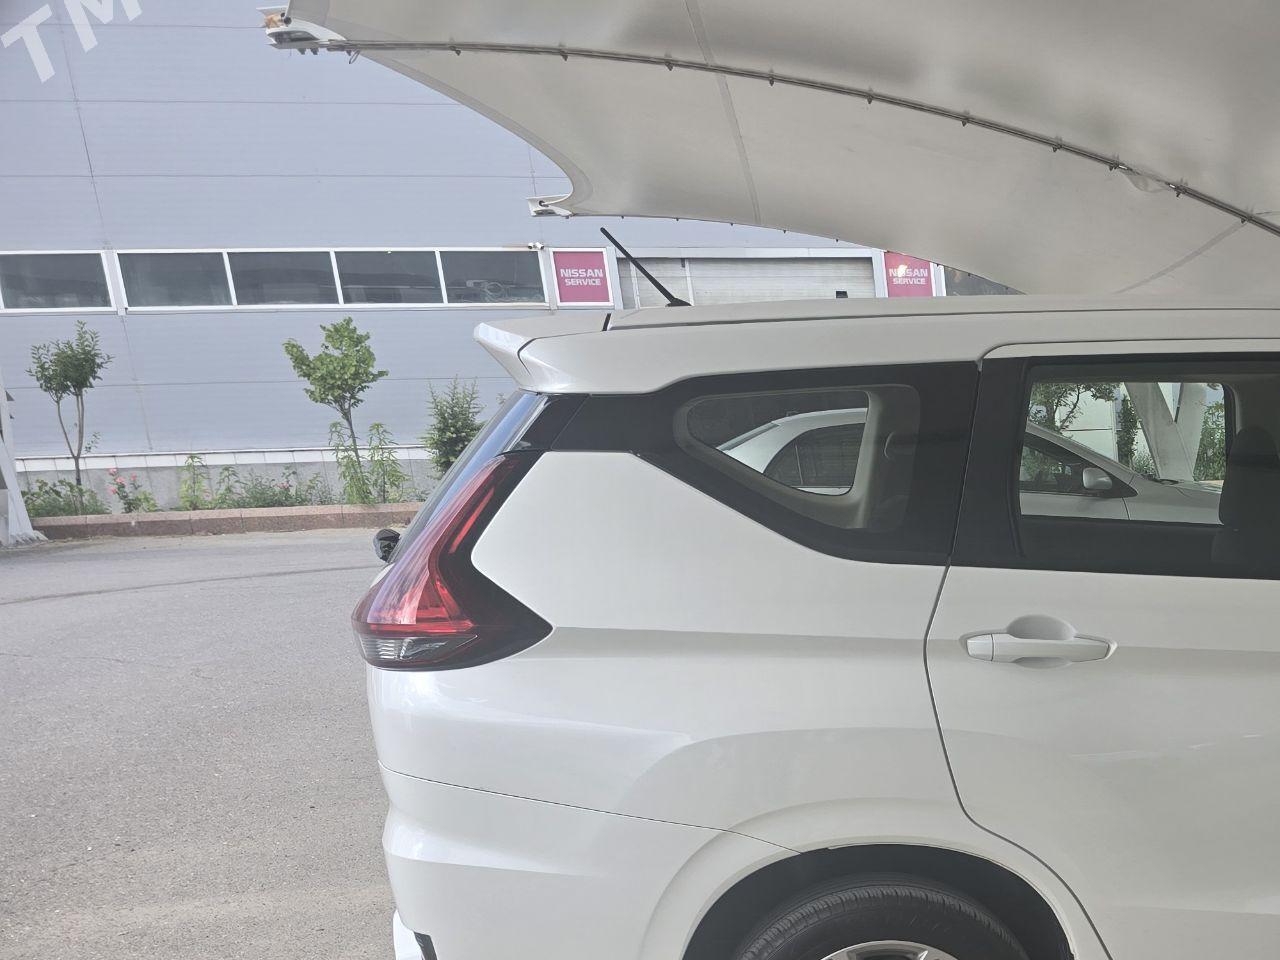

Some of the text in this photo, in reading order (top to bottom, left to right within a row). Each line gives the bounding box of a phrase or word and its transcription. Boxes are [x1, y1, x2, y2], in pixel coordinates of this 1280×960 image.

[560, 268, 604, 278] NISSAN
[888, 268, 929, 277] NSAN
[564, 278, 602, 286] SERVICE
[892, 277, 927, 285] SERVICE
